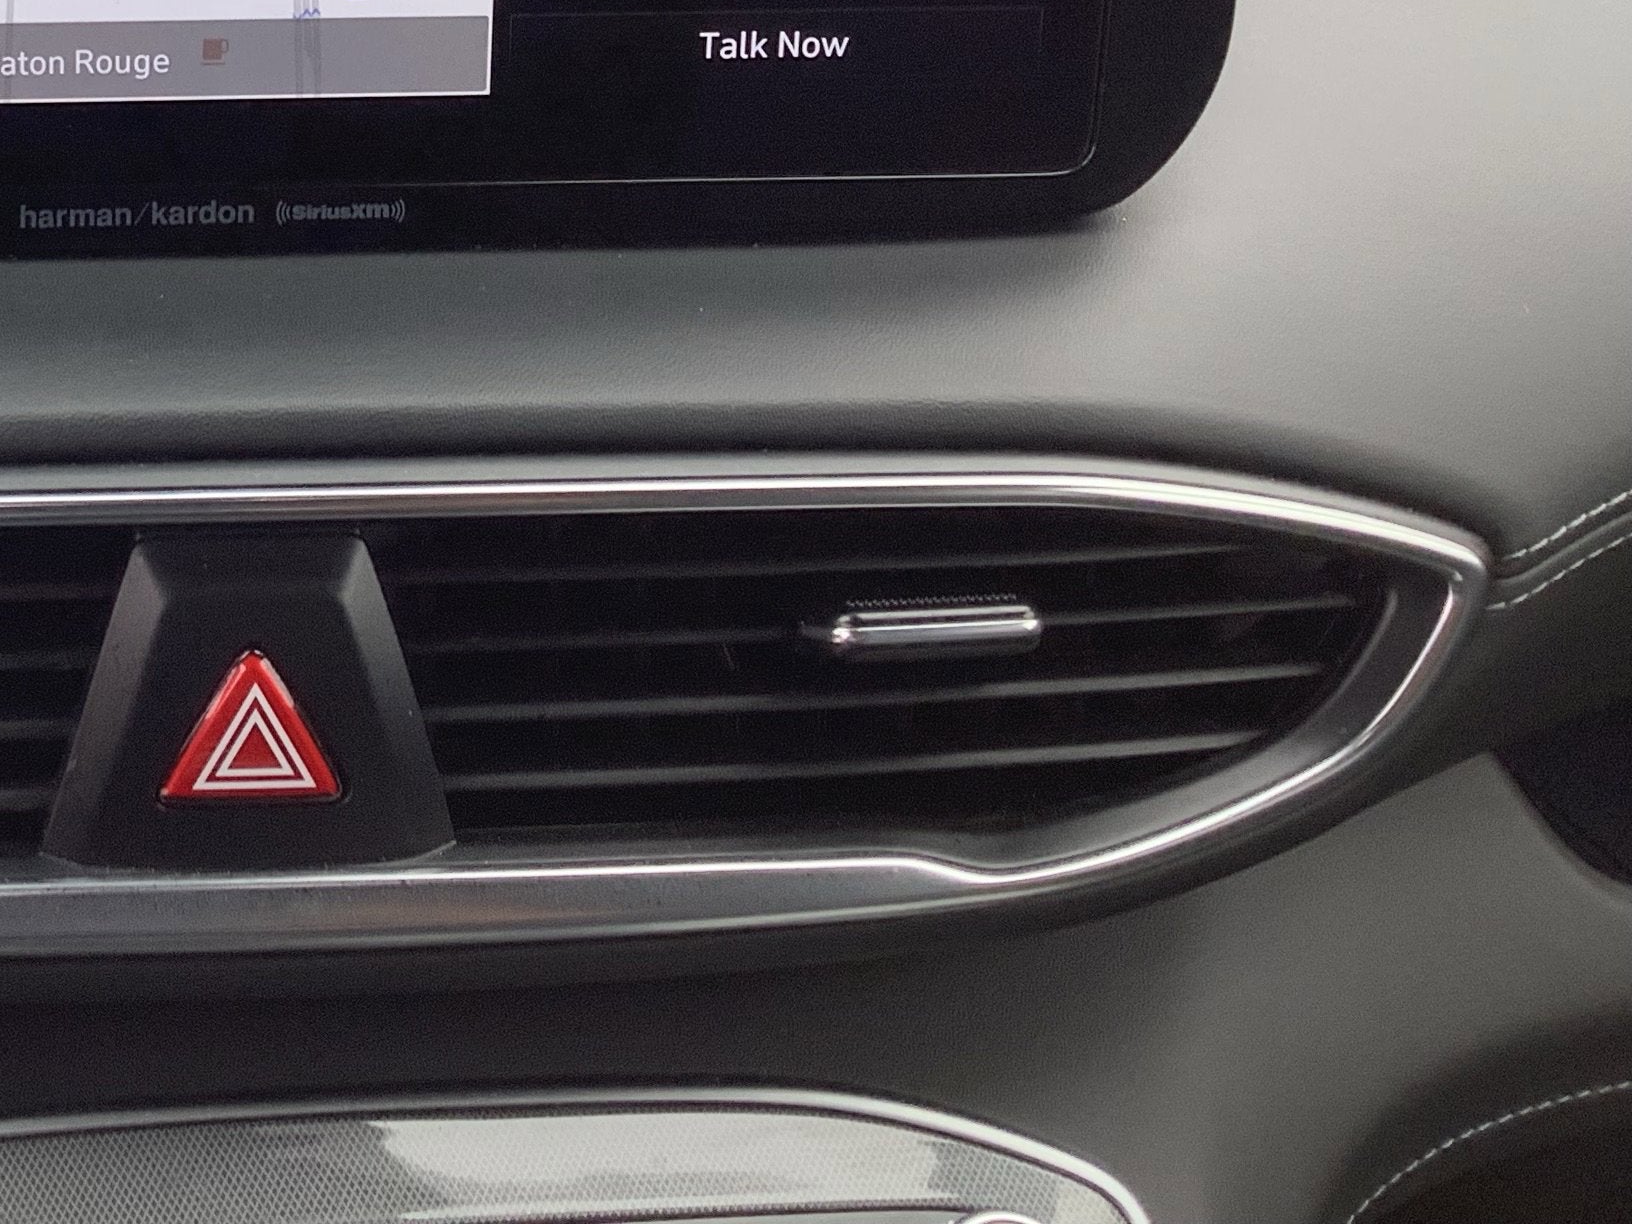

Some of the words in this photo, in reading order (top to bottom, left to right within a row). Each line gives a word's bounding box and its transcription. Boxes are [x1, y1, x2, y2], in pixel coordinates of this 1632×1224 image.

[699, 31, 769, 60] Talk
[778, 32, 850, 59] Now
[74, 49, 171, 81] Rouge
[18, 200, 255, 229] harman/kardon
